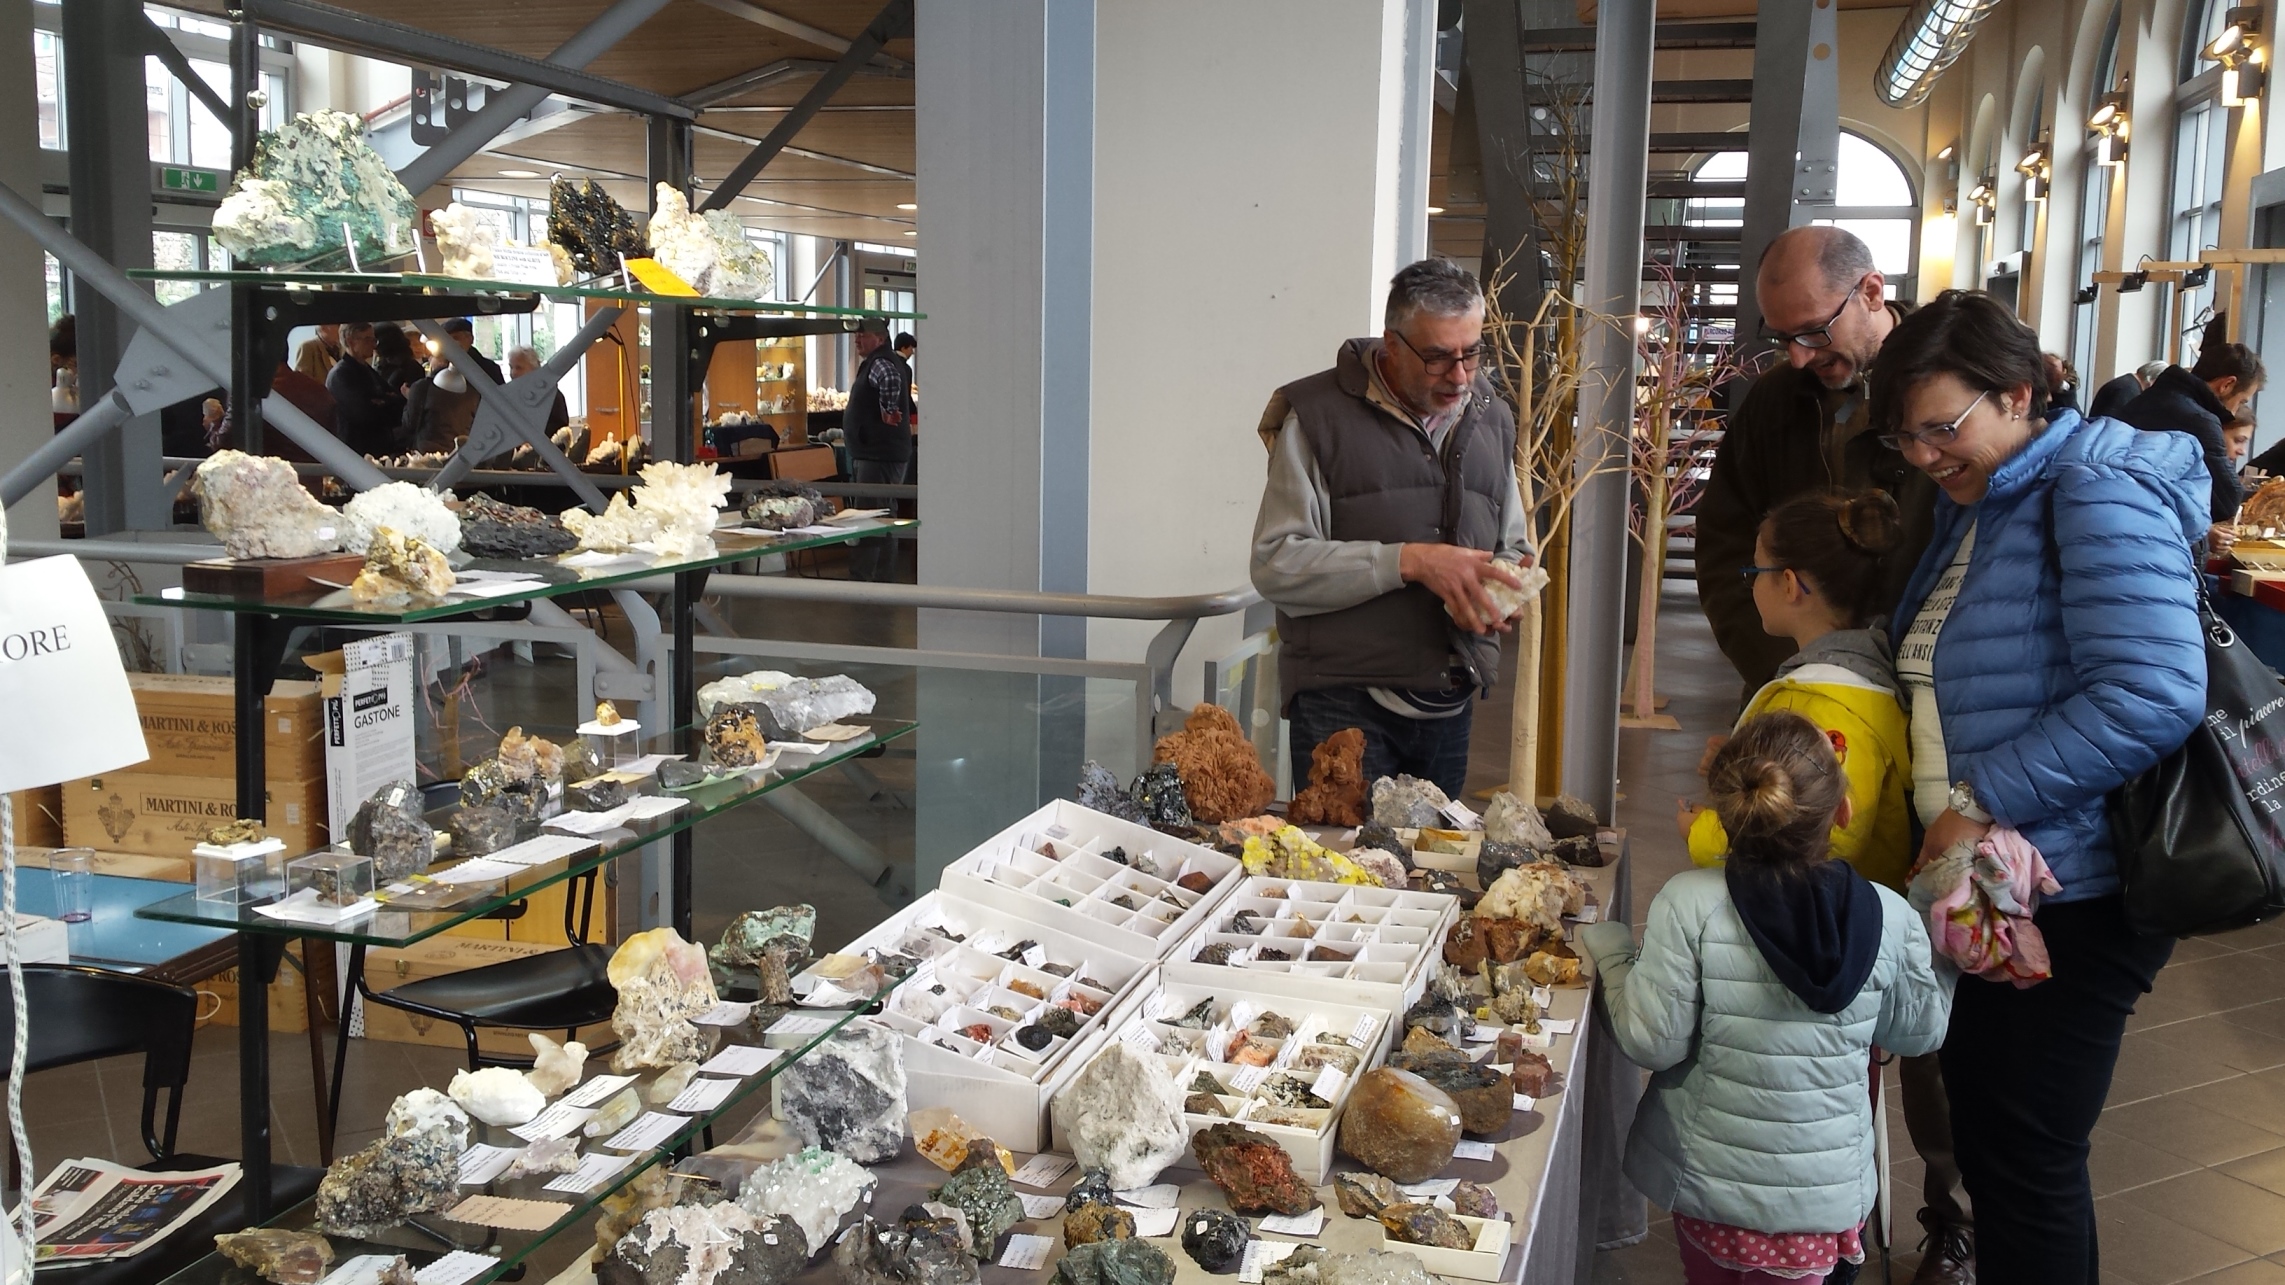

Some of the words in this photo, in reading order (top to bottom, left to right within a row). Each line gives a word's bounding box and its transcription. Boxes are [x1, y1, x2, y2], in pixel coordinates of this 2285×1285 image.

[2, 624, 71, 661] ORE
[196, 719, 209, 733] &
[354, 705, 401, 729] GASTONE
[2207, 709, 2228, 726] ne
[2219, 726, 2238, 741] il
[2239, 697, 2285, 749] piacere
[146, 797, 203, 815] MARTINI
[205, 802, 218, 816] &
[2261, 799, 2282, 814] la
